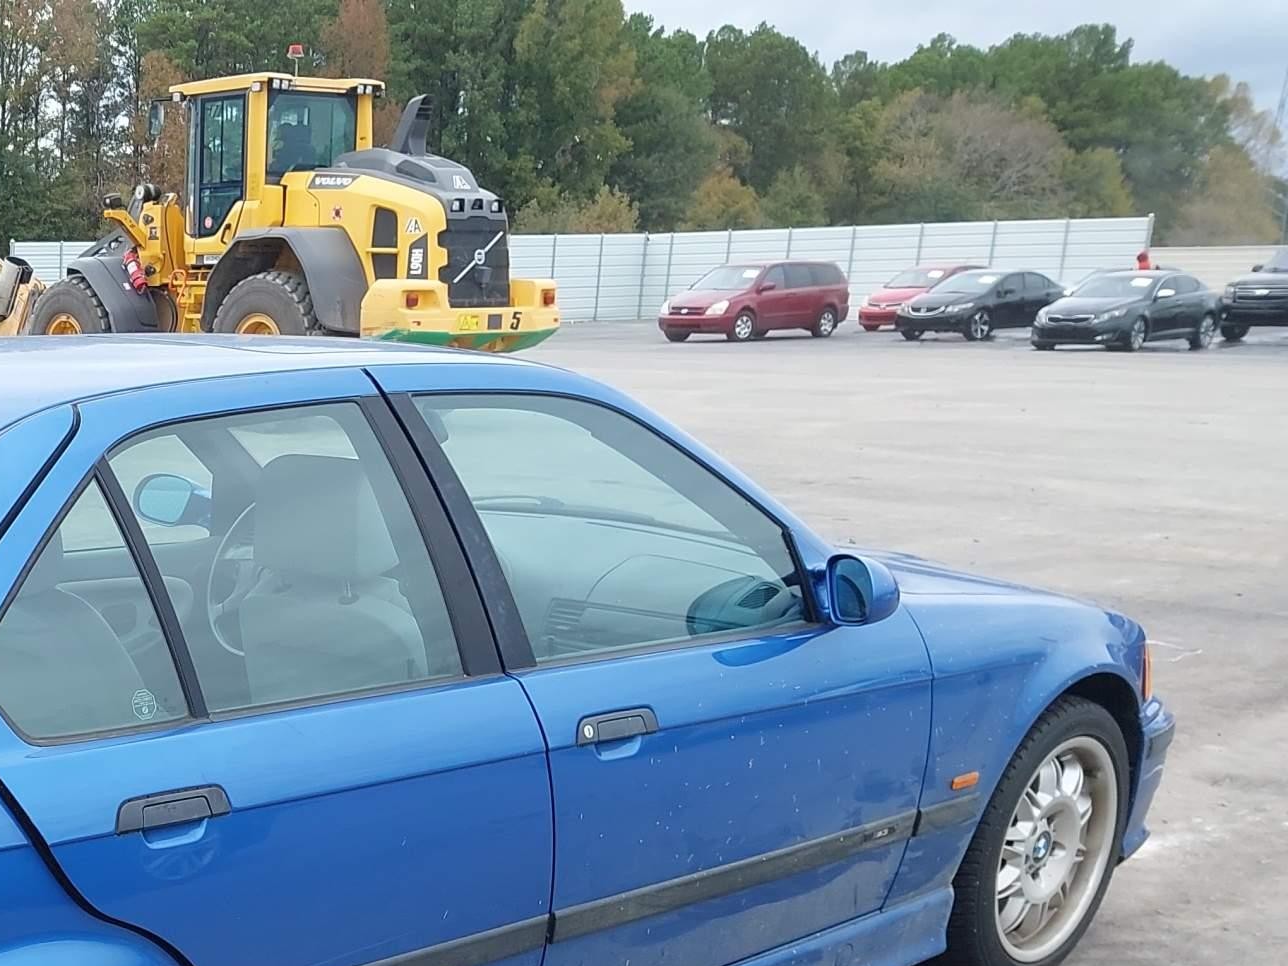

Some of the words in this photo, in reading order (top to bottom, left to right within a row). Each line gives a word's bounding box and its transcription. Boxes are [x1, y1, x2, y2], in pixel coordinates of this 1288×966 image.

[315, 176, 353, 185] VOLVO
[410, 248, 423, 275] L90H
[509, 311, 522, 330] 5
